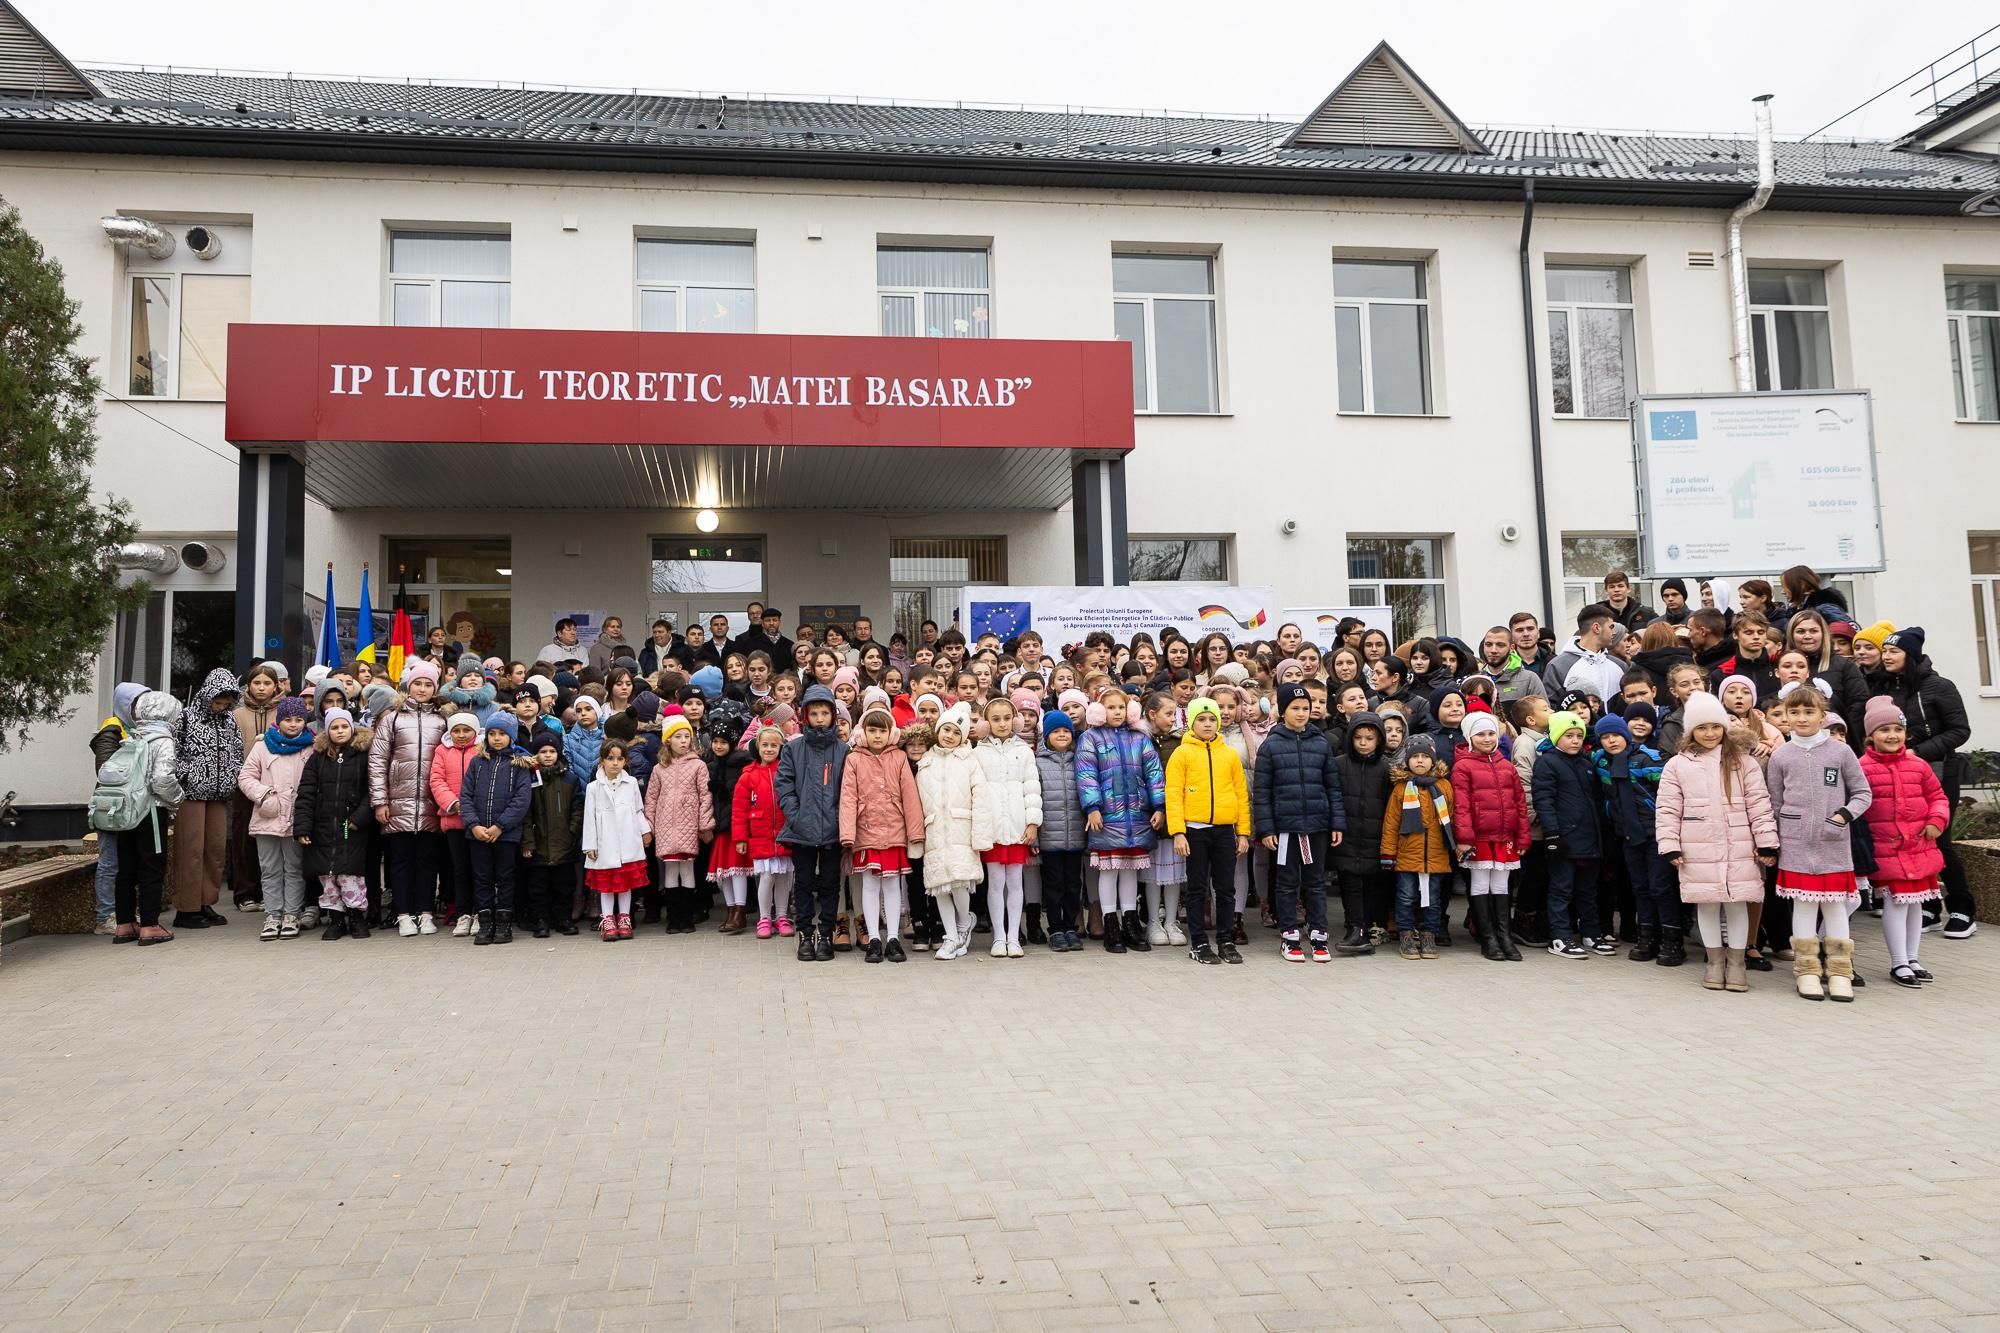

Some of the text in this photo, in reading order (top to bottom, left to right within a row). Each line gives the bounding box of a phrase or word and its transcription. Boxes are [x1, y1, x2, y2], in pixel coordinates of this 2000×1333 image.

[330, 364, 373, 395] IP
[384, 366, 524, 400] LICEUL
[539, 370, 722, 403] TEORETIC
[1561, 694, 1576, 710] NYC
